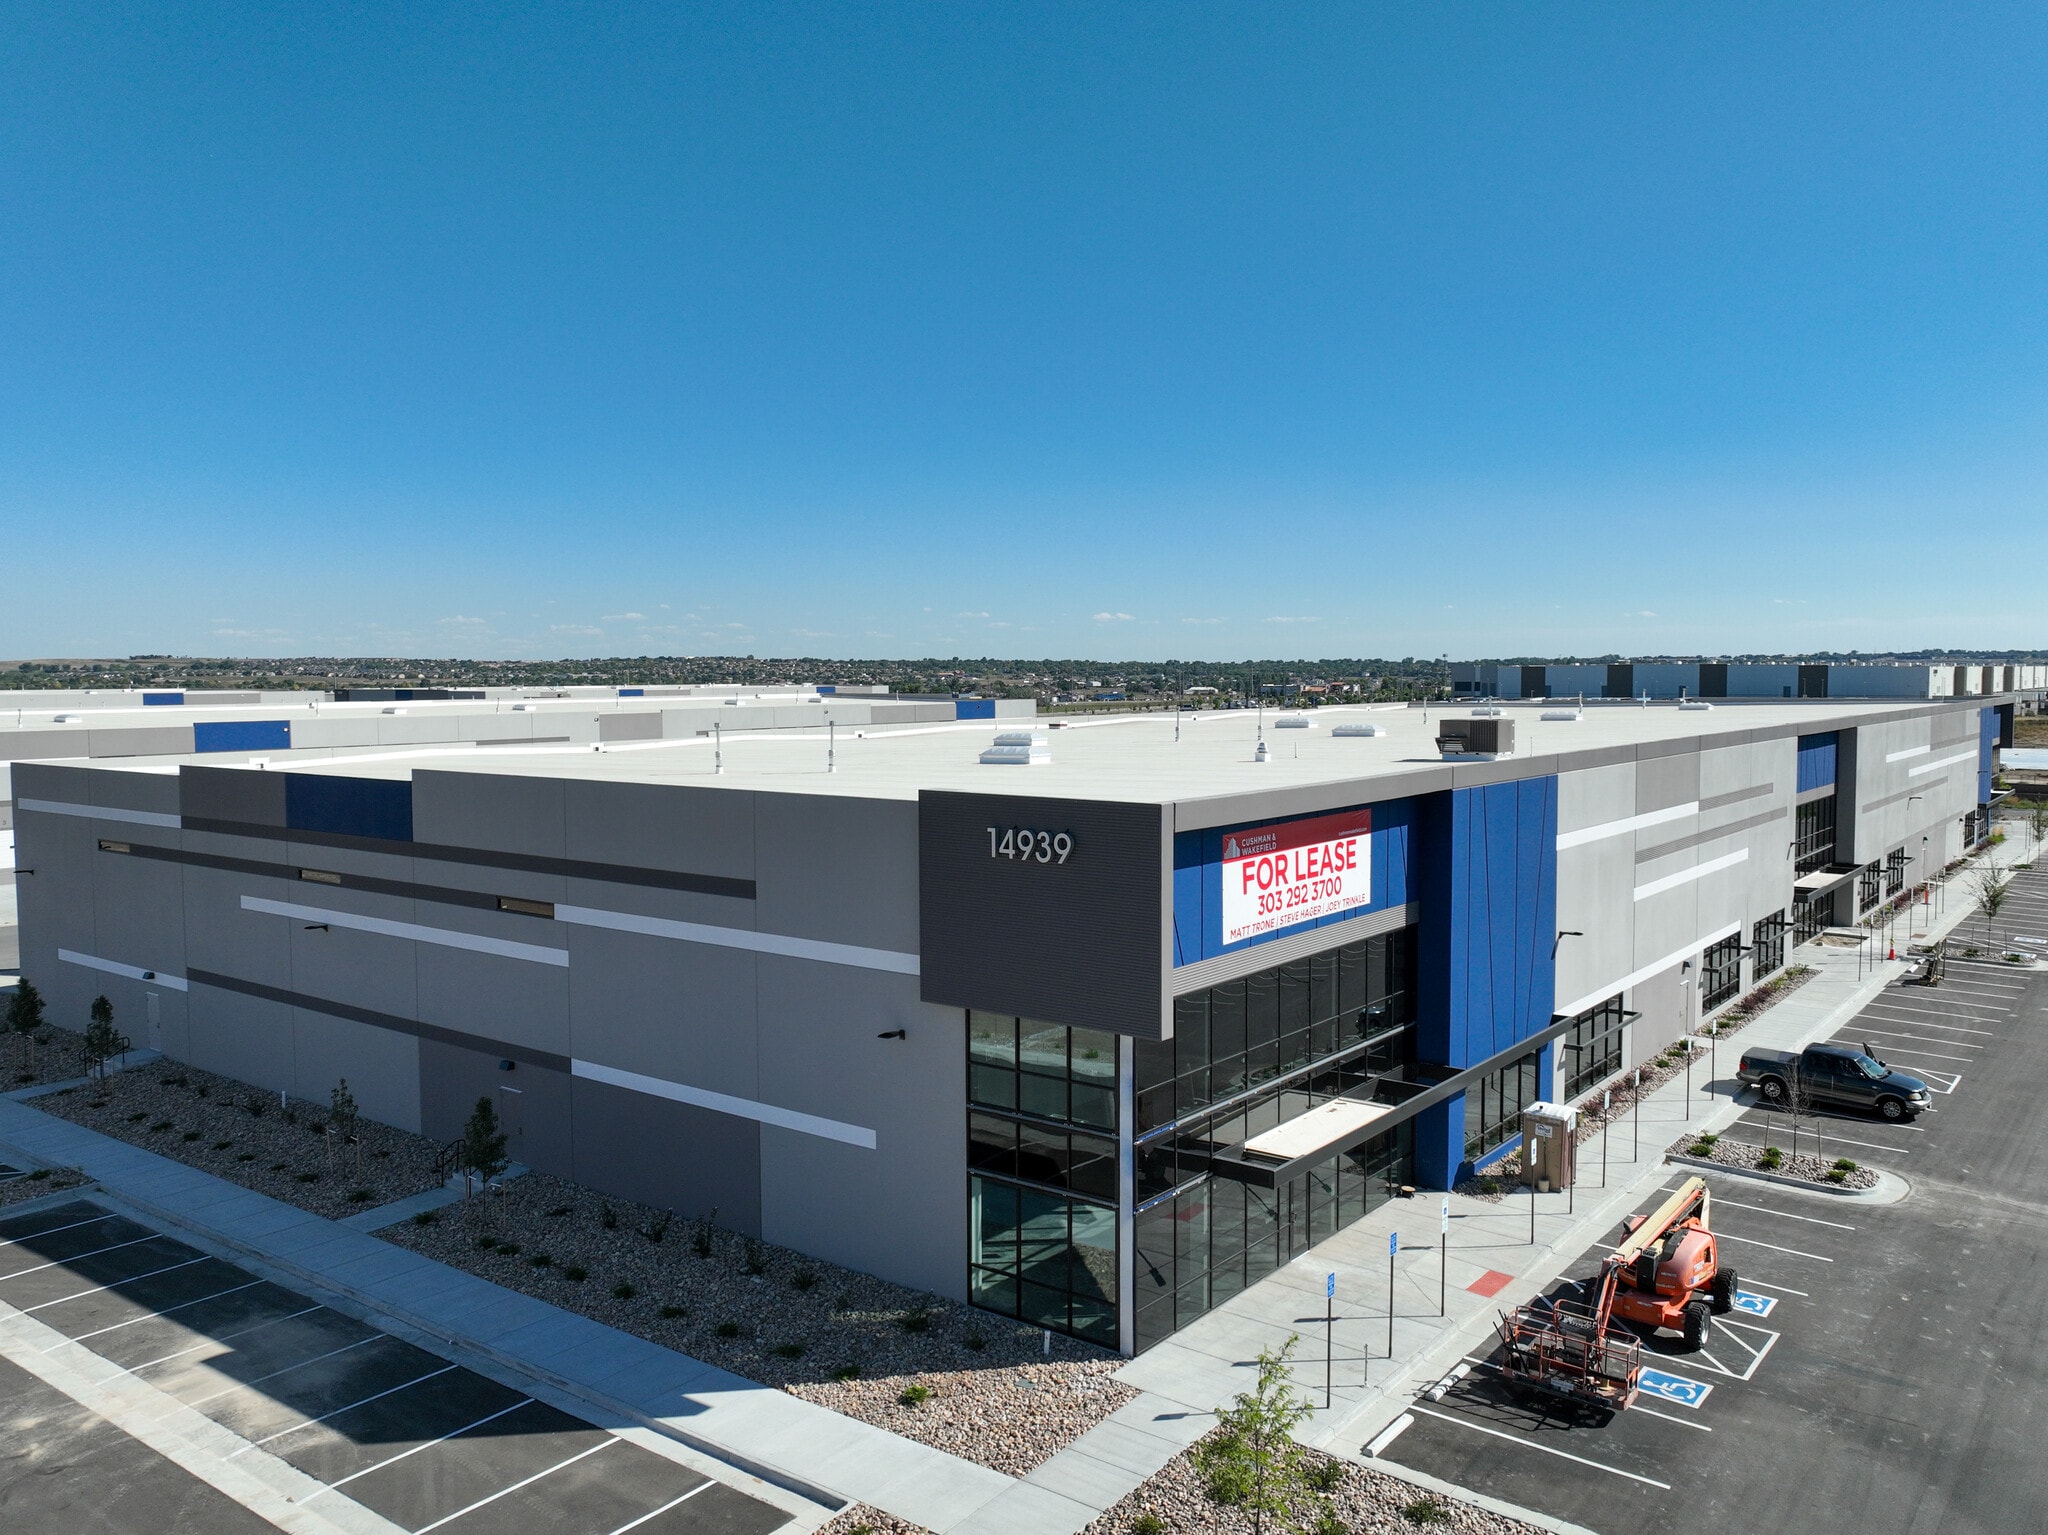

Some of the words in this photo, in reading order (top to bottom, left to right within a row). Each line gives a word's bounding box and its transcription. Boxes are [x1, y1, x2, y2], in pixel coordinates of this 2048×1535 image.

[987, 827, 1072, 865] 14939
[1241, 834, 1271, 847] CUSHMAN
[1241, 842, 1277, 856] WAKEFIELD
[1242, 854, 1289, 895] FOR
[1295, 839, 1357, 882] LEASE
[1257, 890, 1283, 916] 303
[1286, 884, 1308, 908] 292
[1311, 876, 1342, 901] 3700
[1230, 924, 1251, 940] MATT
[1252, 918, 1275, 934] TRONE
[1279, 911, 1299, 925] STEVE
[1300, 905, 1321, 920] HAGER
[1325, 900, 1341, 913] JOEY
[1342, 893, 1366, 908] TRINKLE
